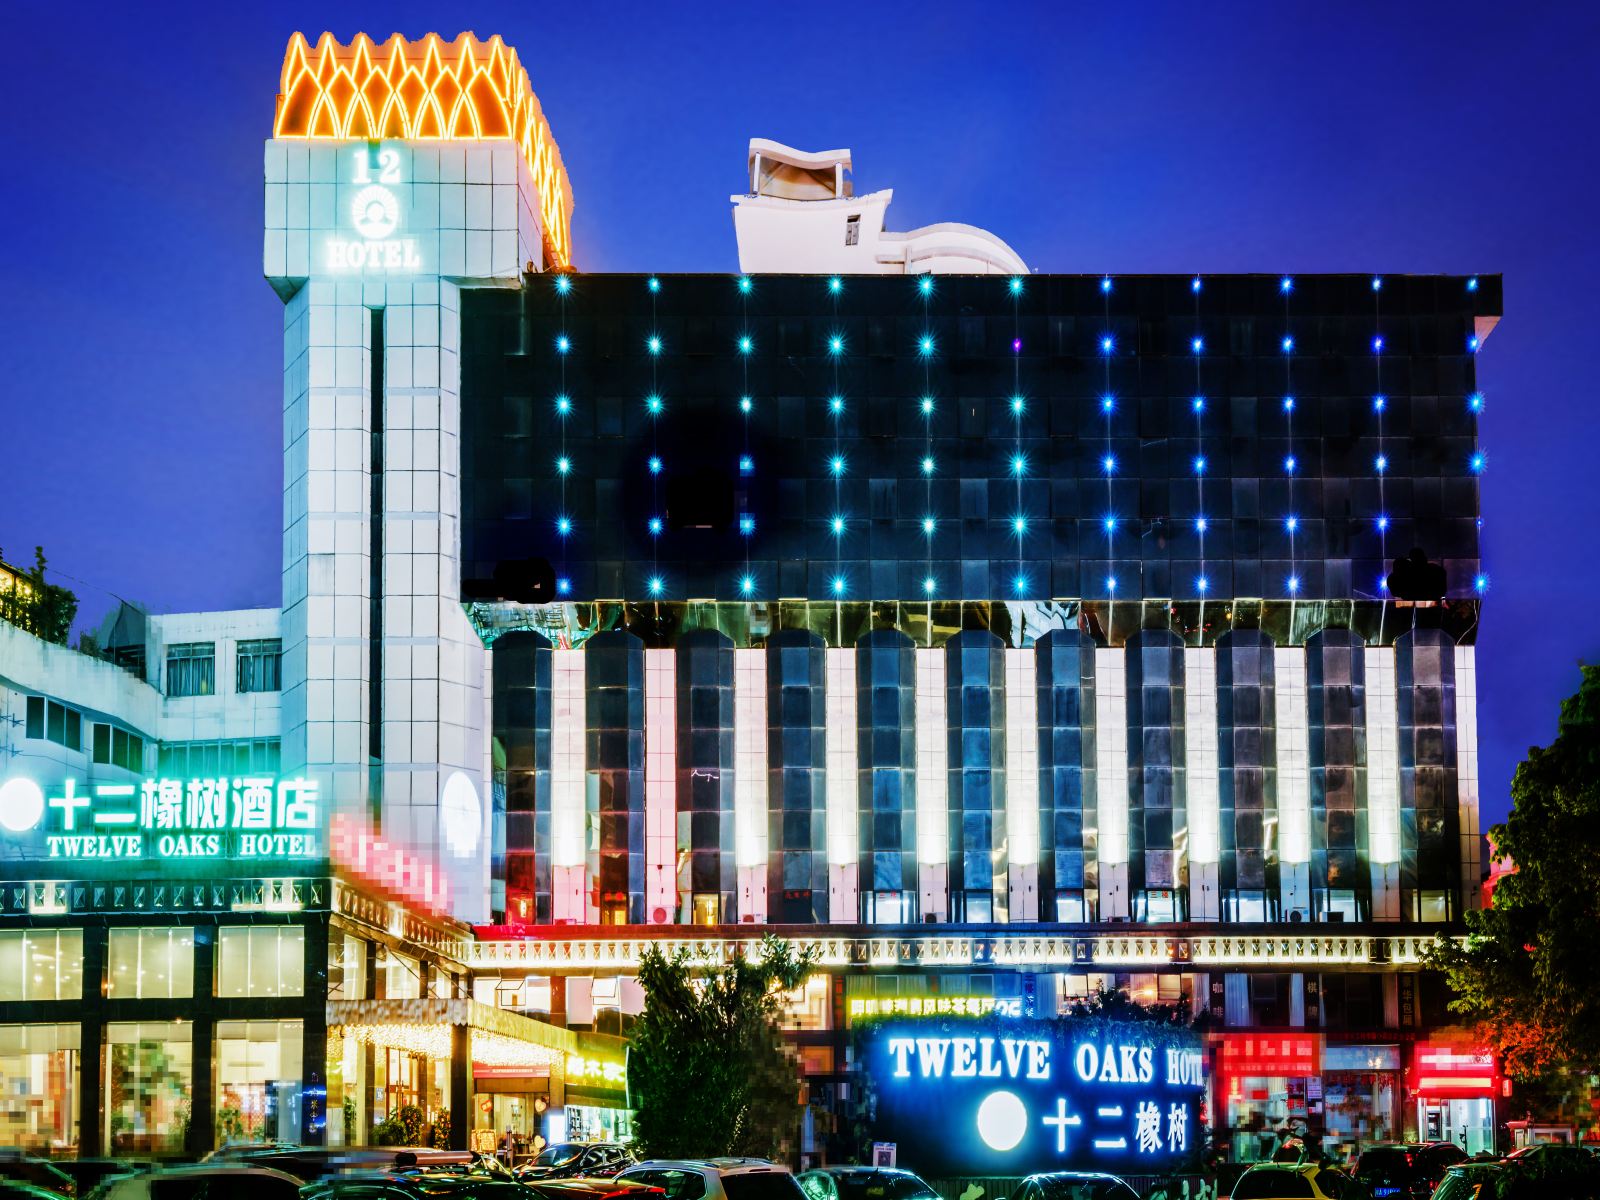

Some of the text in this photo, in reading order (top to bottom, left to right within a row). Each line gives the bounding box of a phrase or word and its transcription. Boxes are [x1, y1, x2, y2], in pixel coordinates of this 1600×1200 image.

[353, 150, 400, 183] 12
[327, 239, 420, 269] HOTEL
[49, 777, 320, 829] 十二橡树酒店
[47, 834, 316, 857] TWELVE OAKS HOTEL
[889, 1038, 1050, 1078] TWELVE
[1076, 1043, 1153, 1083] OAKS
[1043, 1098, 1188, 1153] 十二橡树
